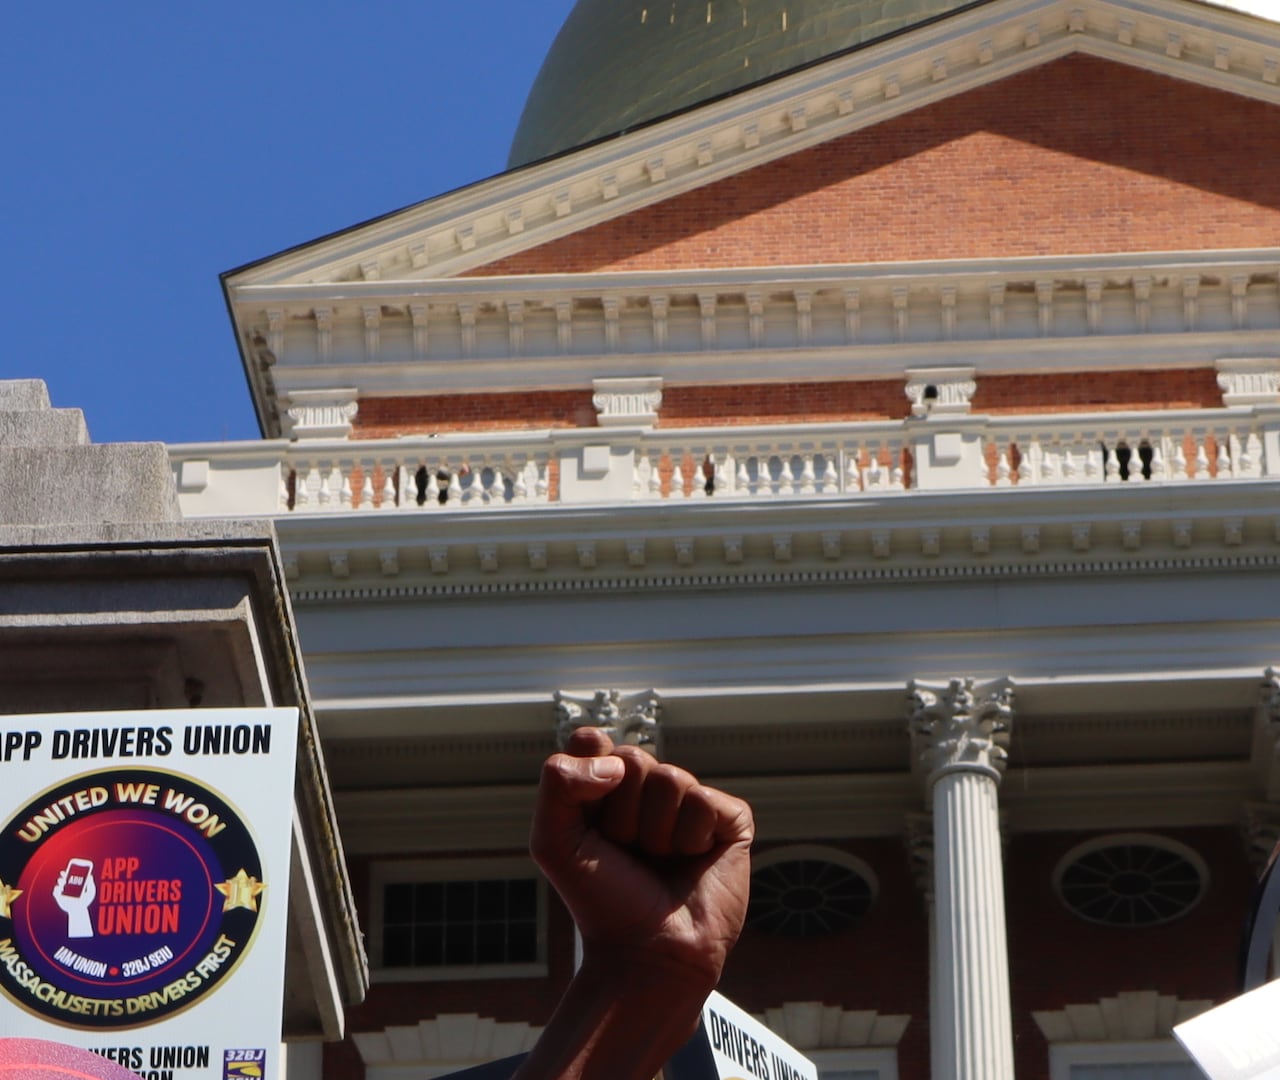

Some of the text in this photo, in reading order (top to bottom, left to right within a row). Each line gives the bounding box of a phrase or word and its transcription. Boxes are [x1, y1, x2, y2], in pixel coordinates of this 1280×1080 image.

[51, 726, 173, 760] DRIVERS
[183, 724, 272, 756] UNION
[18, 783, 227, 843] UNITED WE WON
[101, 857, 140, 880] APP
[100, 879, 182, 904] DRIVERS
[98, 903, 180, 936] UNION
[72, 953, 108, 978] UNION
[121, 956, 152, 978] 32BJ
[149, 945, 174, 969] SEIU
[125, 971, 202, 1015] DRIVERS
[196, 934, 237, 981] FIRST
[150, 1046, 209, 1069] UNION
[225, 1050, 263, 1061] 32BJ
